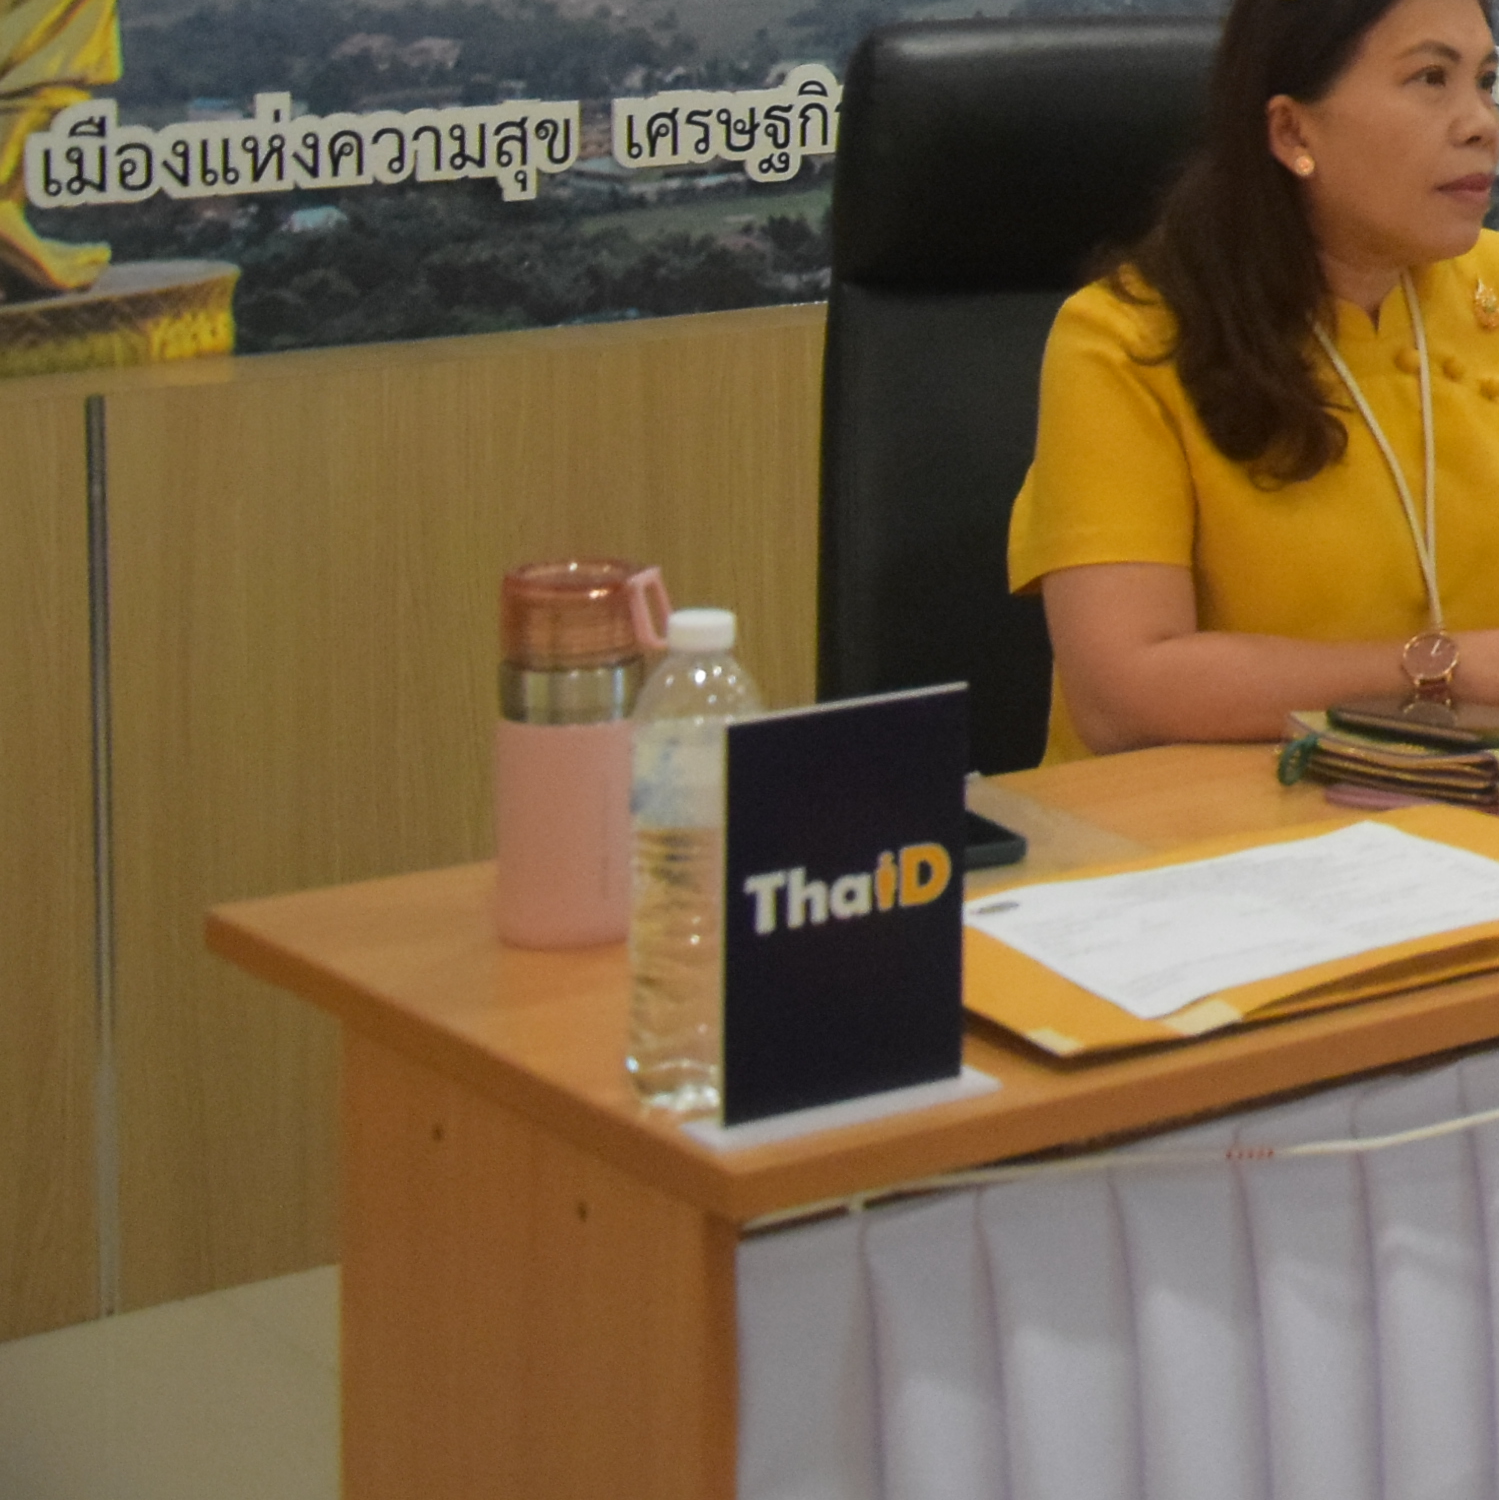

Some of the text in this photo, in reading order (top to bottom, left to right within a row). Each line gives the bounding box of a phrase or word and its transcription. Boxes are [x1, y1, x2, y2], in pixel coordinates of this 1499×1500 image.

[42, 109, 574, 193] เมืองแห่งความสุข
[624, 78, 844, 173] เศรษฐกิ
